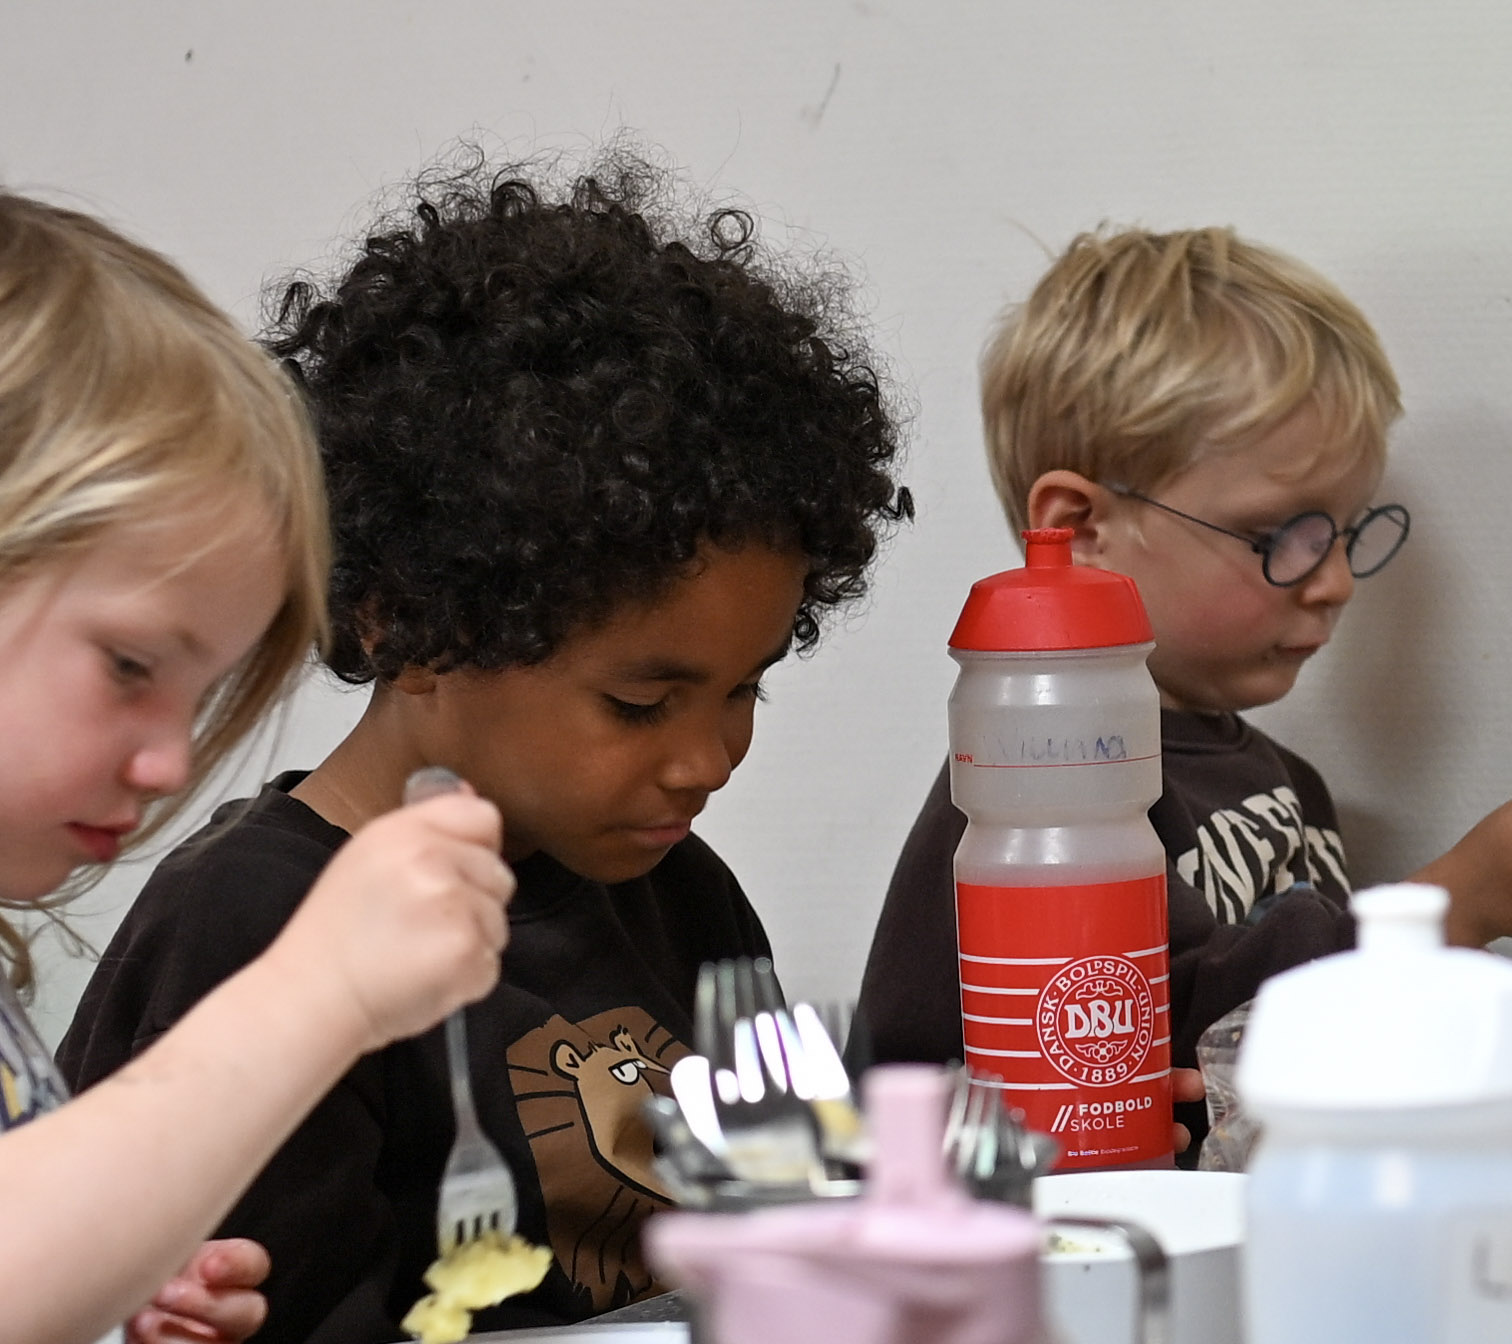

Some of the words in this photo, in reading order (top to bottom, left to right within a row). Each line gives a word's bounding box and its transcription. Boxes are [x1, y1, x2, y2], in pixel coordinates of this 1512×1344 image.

[1064, 999, 1135, 1038] DBU
[1041, 996, 1075, 1071] DANSK
[1080, 1063, 1128, 1083] 1889
[1078, 1096, 1152, 1116] FODBOLD
[1070, 1115, 1125, 1132] SKOLE
